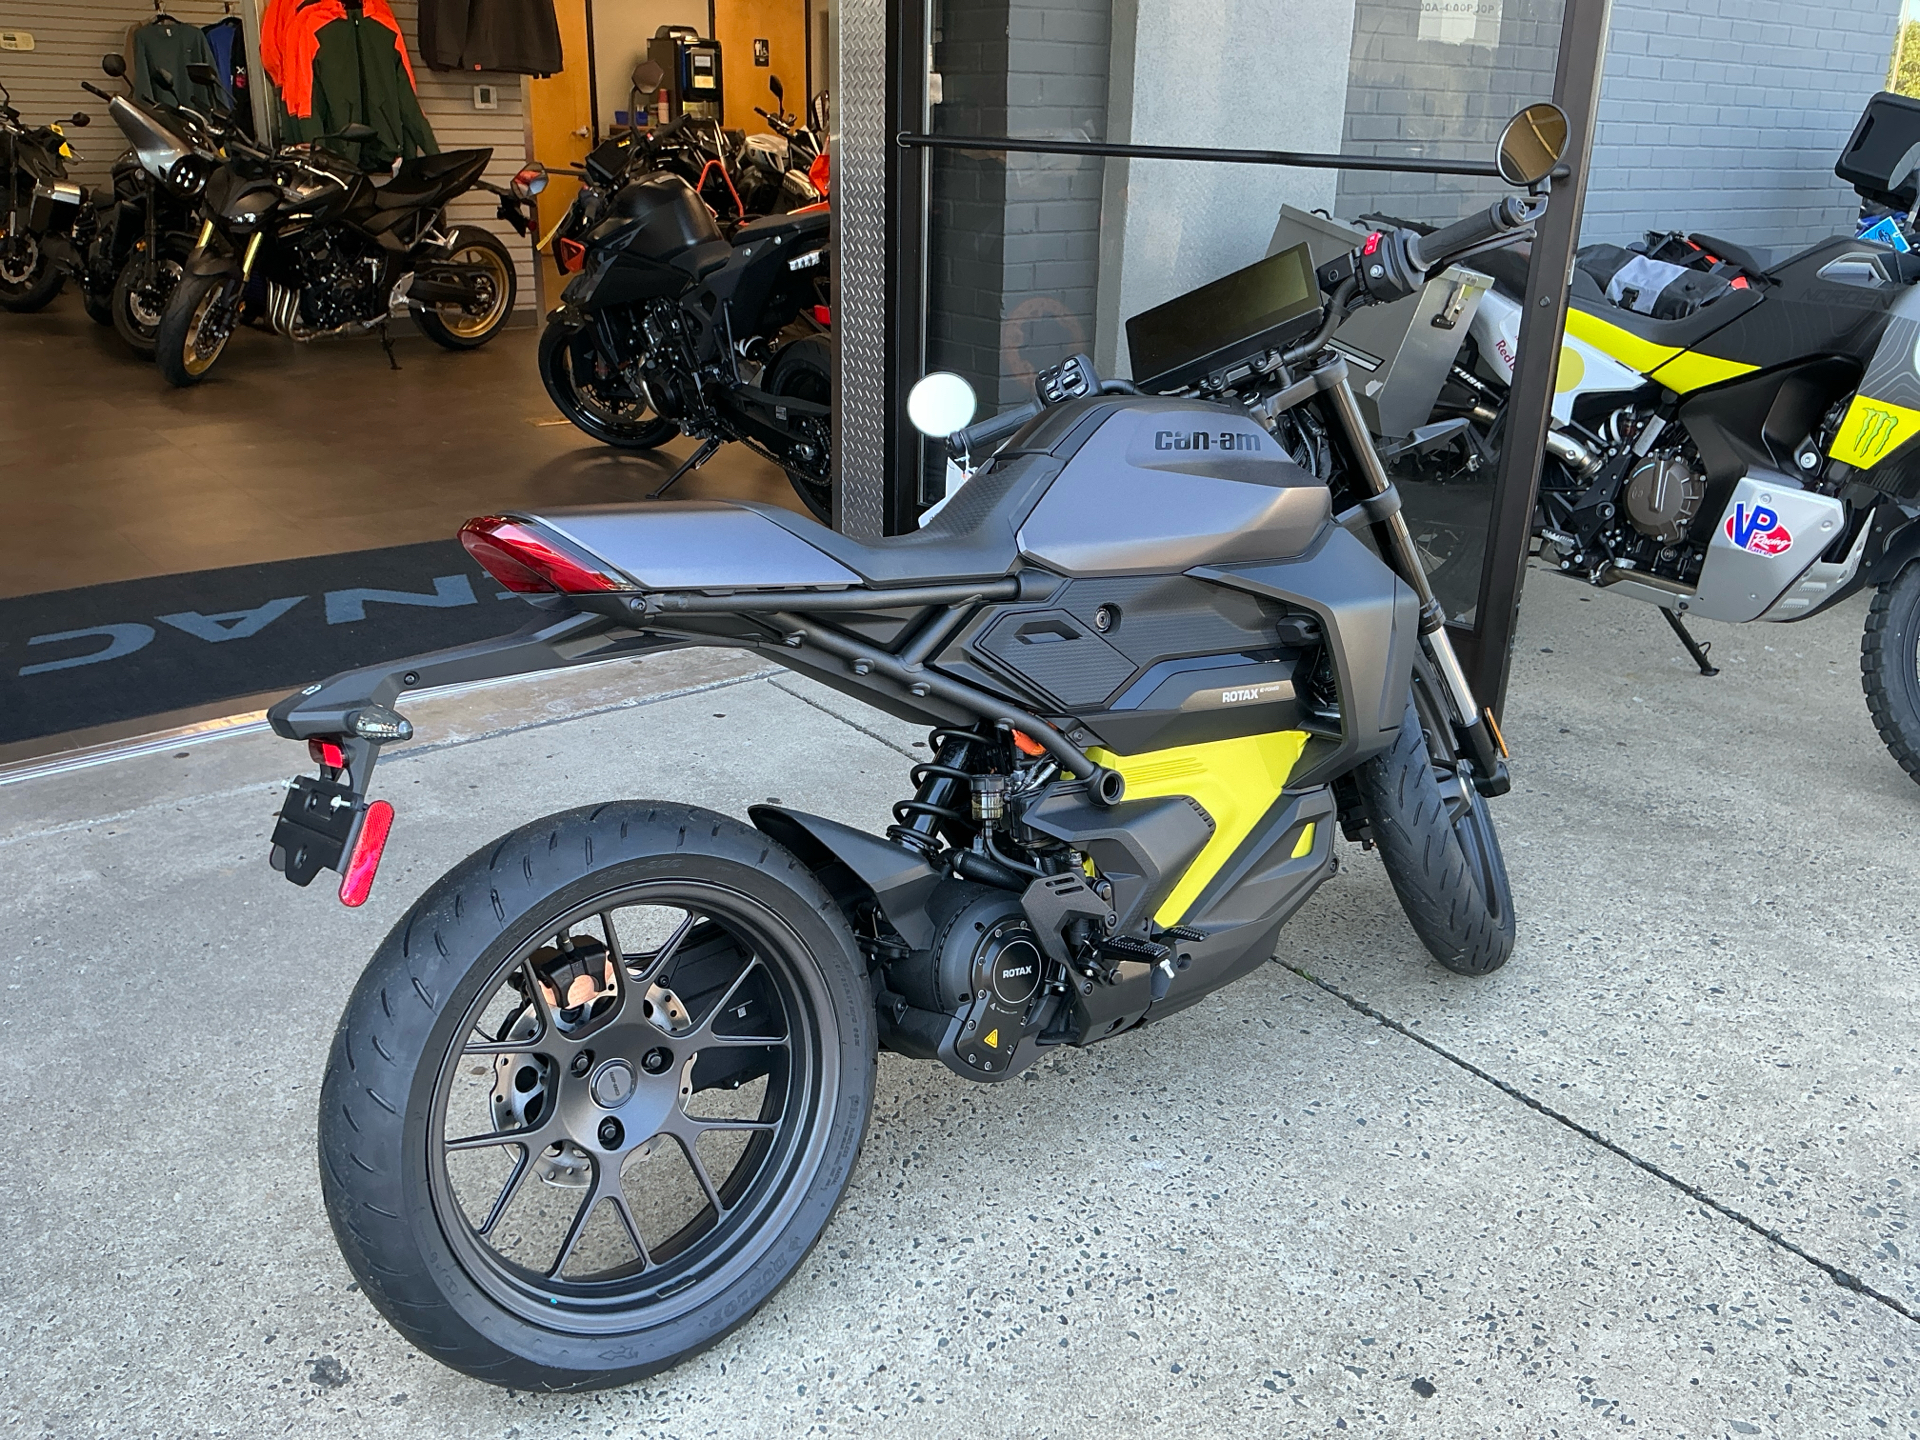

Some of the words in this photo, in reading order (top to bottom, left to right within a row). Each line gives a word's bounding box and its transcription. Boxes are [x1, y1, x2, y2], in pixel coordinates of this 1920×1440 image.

[1798, 287, 1896, 311] NORDEN
[1452, 365, 1486, 391] TUSK
[1154, 428, 1262, 452] can-am
[1734, 503, 1778, 550] VP
[1751, 533, 1793, 552] Racing
[1222, 688, 1259, 703] ROTAX
[1002, 965, 1033, 979] ROTAX
[708, 1251, 788, 1329] DUNLOP
